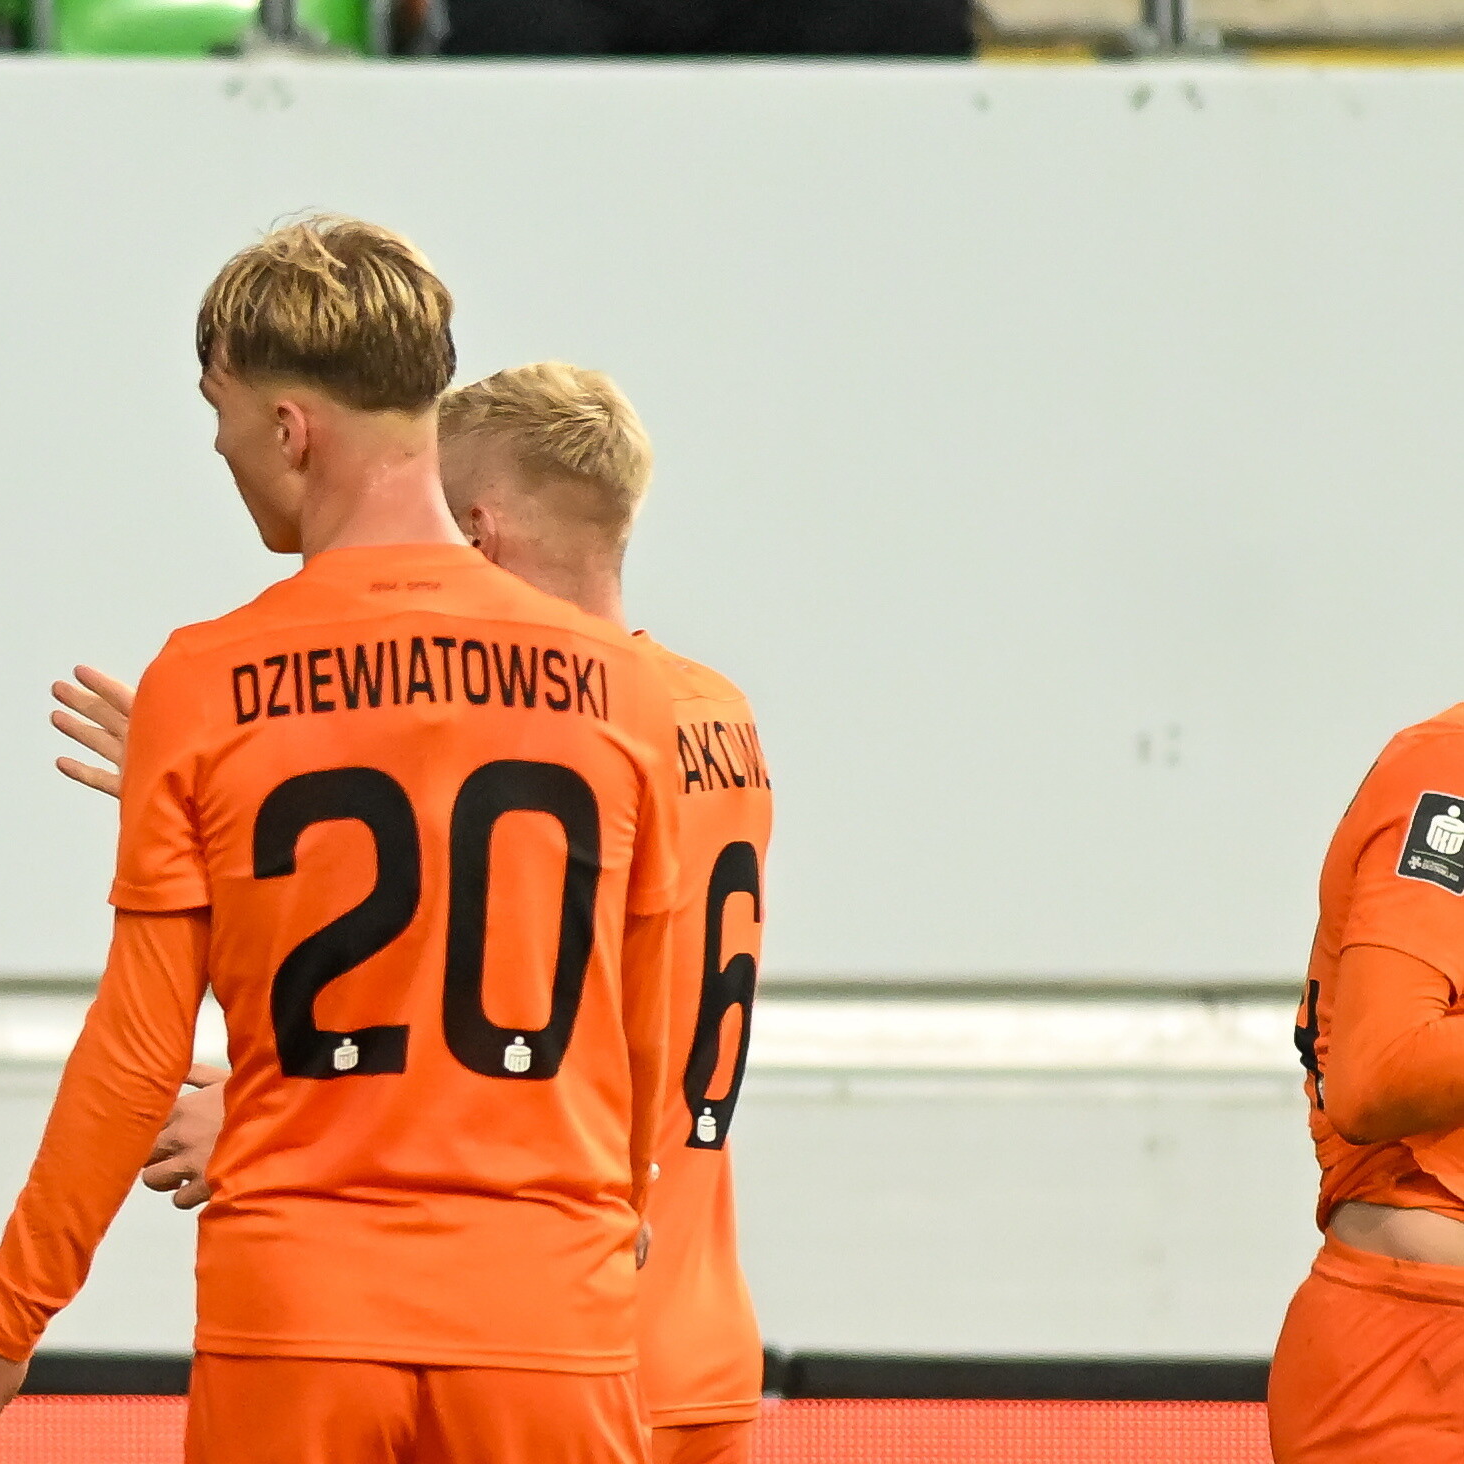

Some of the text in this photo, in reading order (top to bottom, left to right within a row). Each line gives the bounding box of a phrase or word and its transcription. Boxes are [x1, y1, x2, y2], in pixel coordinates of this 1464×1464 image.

[233, 635, 609, 725] DZIEWIATOWSKI
[676, 720, 770, 794] AKOW
[253, 759, 602, 1080] 20
[683, 841, 761, 1150] 6
